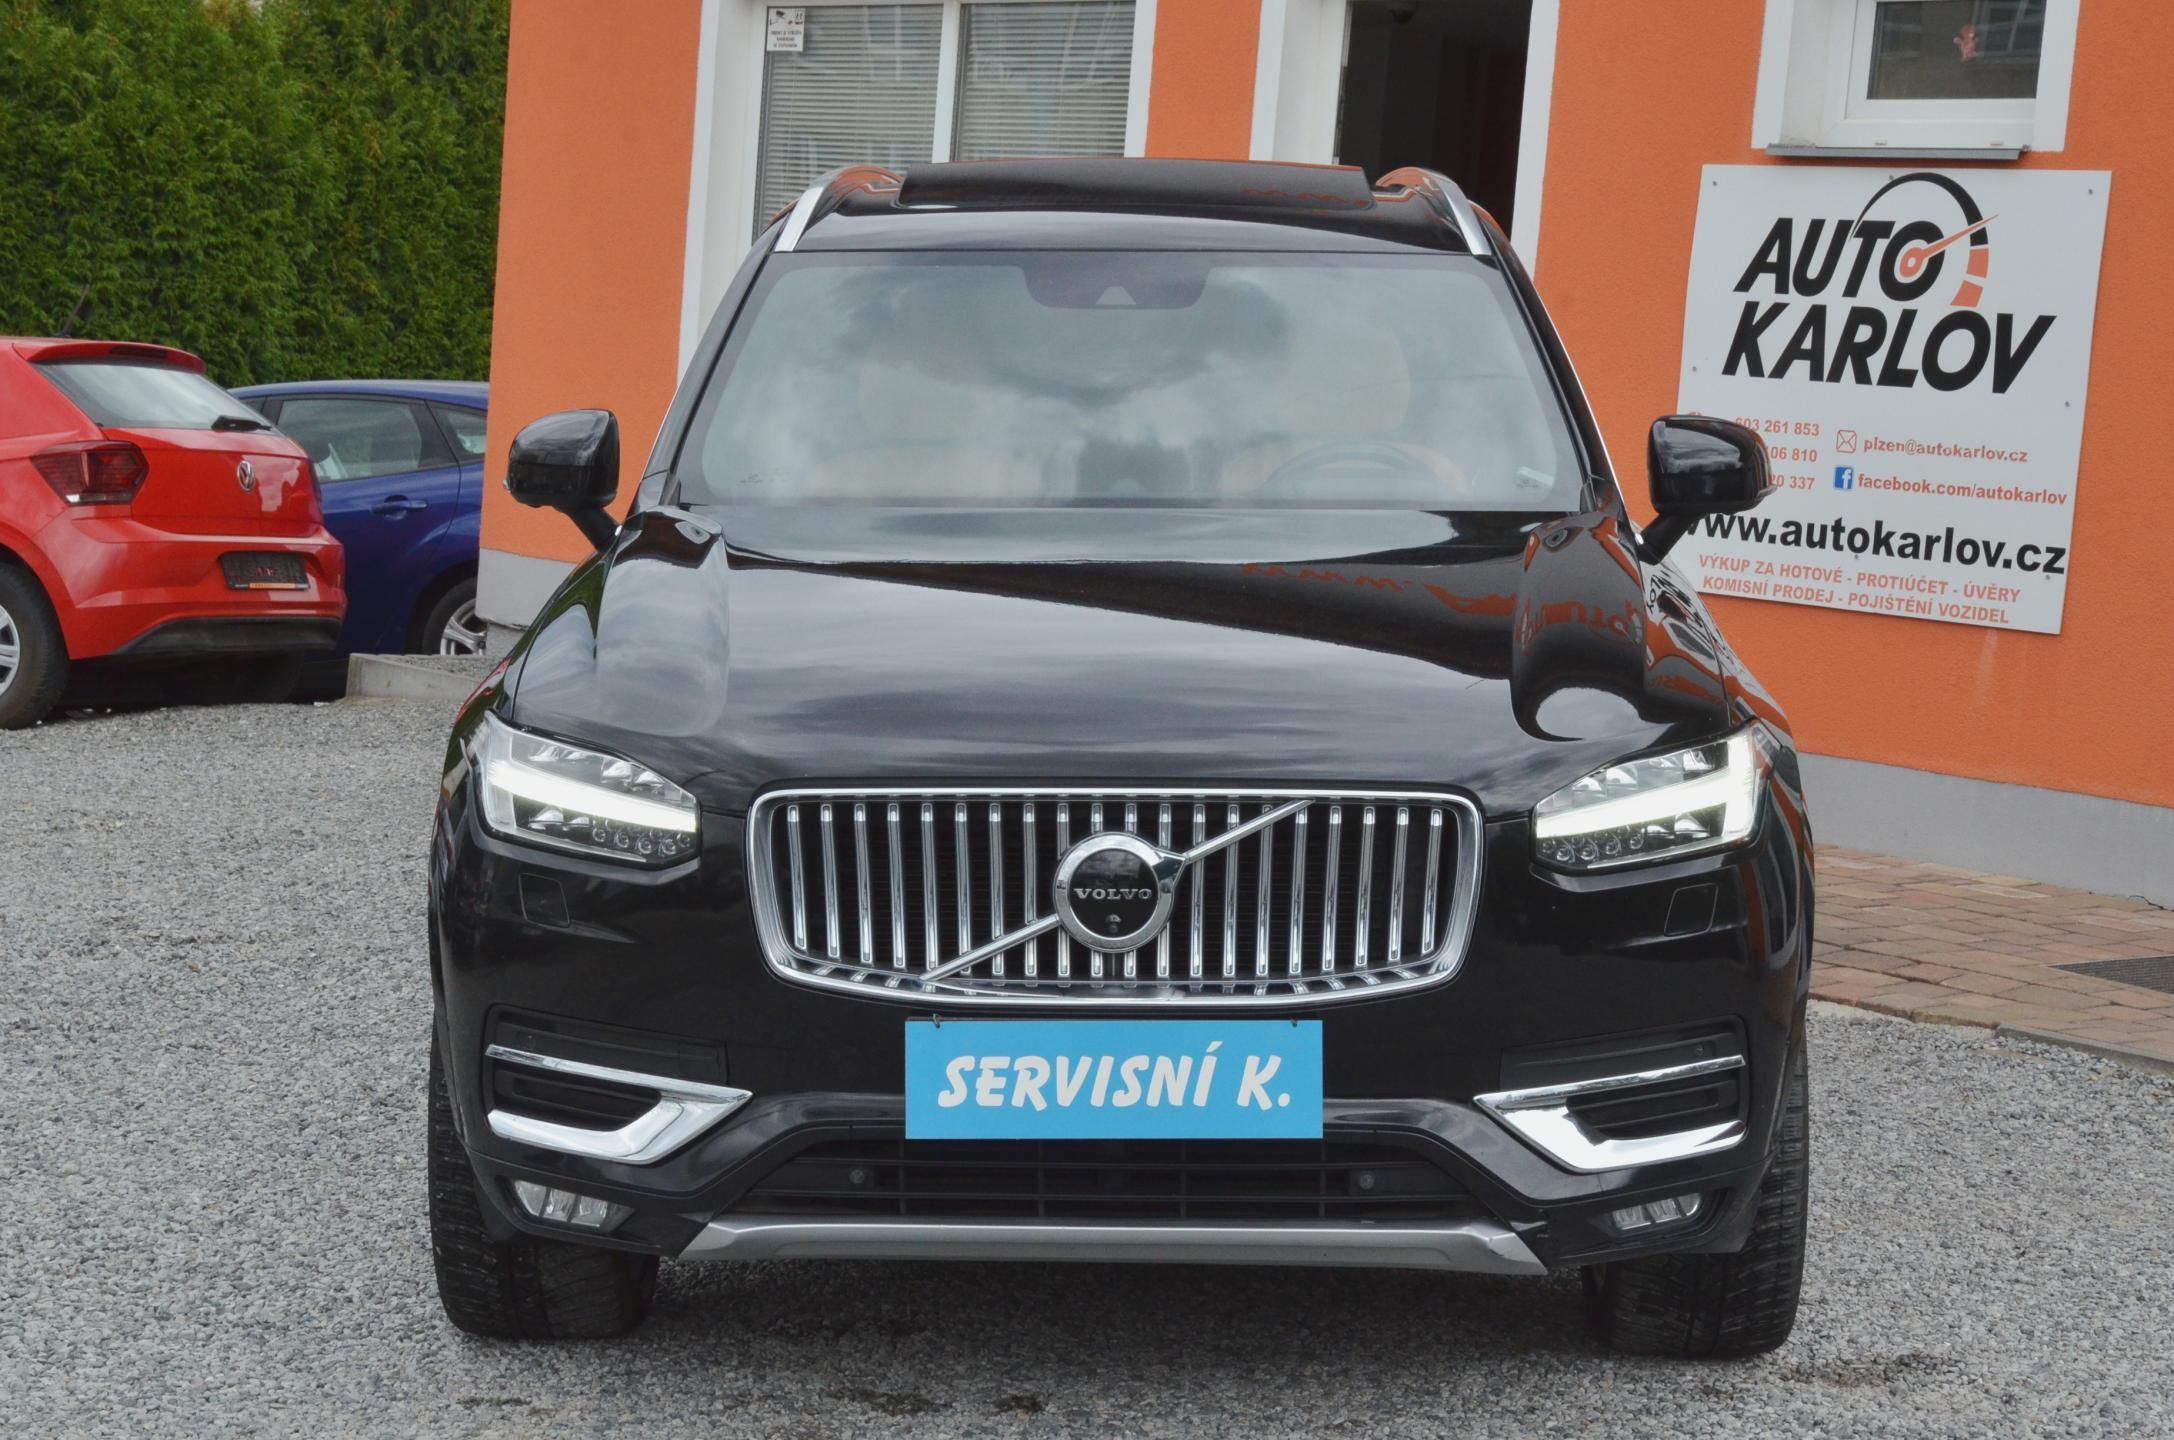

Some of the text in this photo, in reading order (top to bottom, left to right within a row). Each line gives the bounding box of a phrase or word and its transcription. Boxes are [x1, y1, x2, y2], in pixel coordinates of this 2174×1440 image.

[1733, 217, 1946, 301] AUTO
[1721, 301, 2057, 394] KARLOV
[1764, 420, 1789, 434] 261
[1794, 422, 1820, 437] 853
[1792, 447, 1818, 463] 810
[1863, 436, 2029, 463] plzen@autokarlov.cz
[1789, 475, 1815, 490] 337
[1857, 472, 2067, 505] facebook.com/autokarlov
[1687, 514, 2067, 574] ww.autokarlov.cz
[1699, 553, 1751, 573] VÝKUP
[1754, 560, 1775, 576] ZA
[1779, 563, 1843, 584] HOTOVÉ
[1856, 571, 1949, 595] PROTIÚČET
[1963, 581, 2021, 603] ÚVĚRY
[1703, 575, 1769, 596] KOMISNÍ
[1772, 583, 1834, 604] PRODEJ
[1847, 592, 1933, 615] POJIŠTĚNÍ
[1938, 602, 2009, 624] VOZIDEL
[1073, 888, 1152, 900] VOLVO
[937, 1041, 1291, 1112] SERVISNÍ K.
